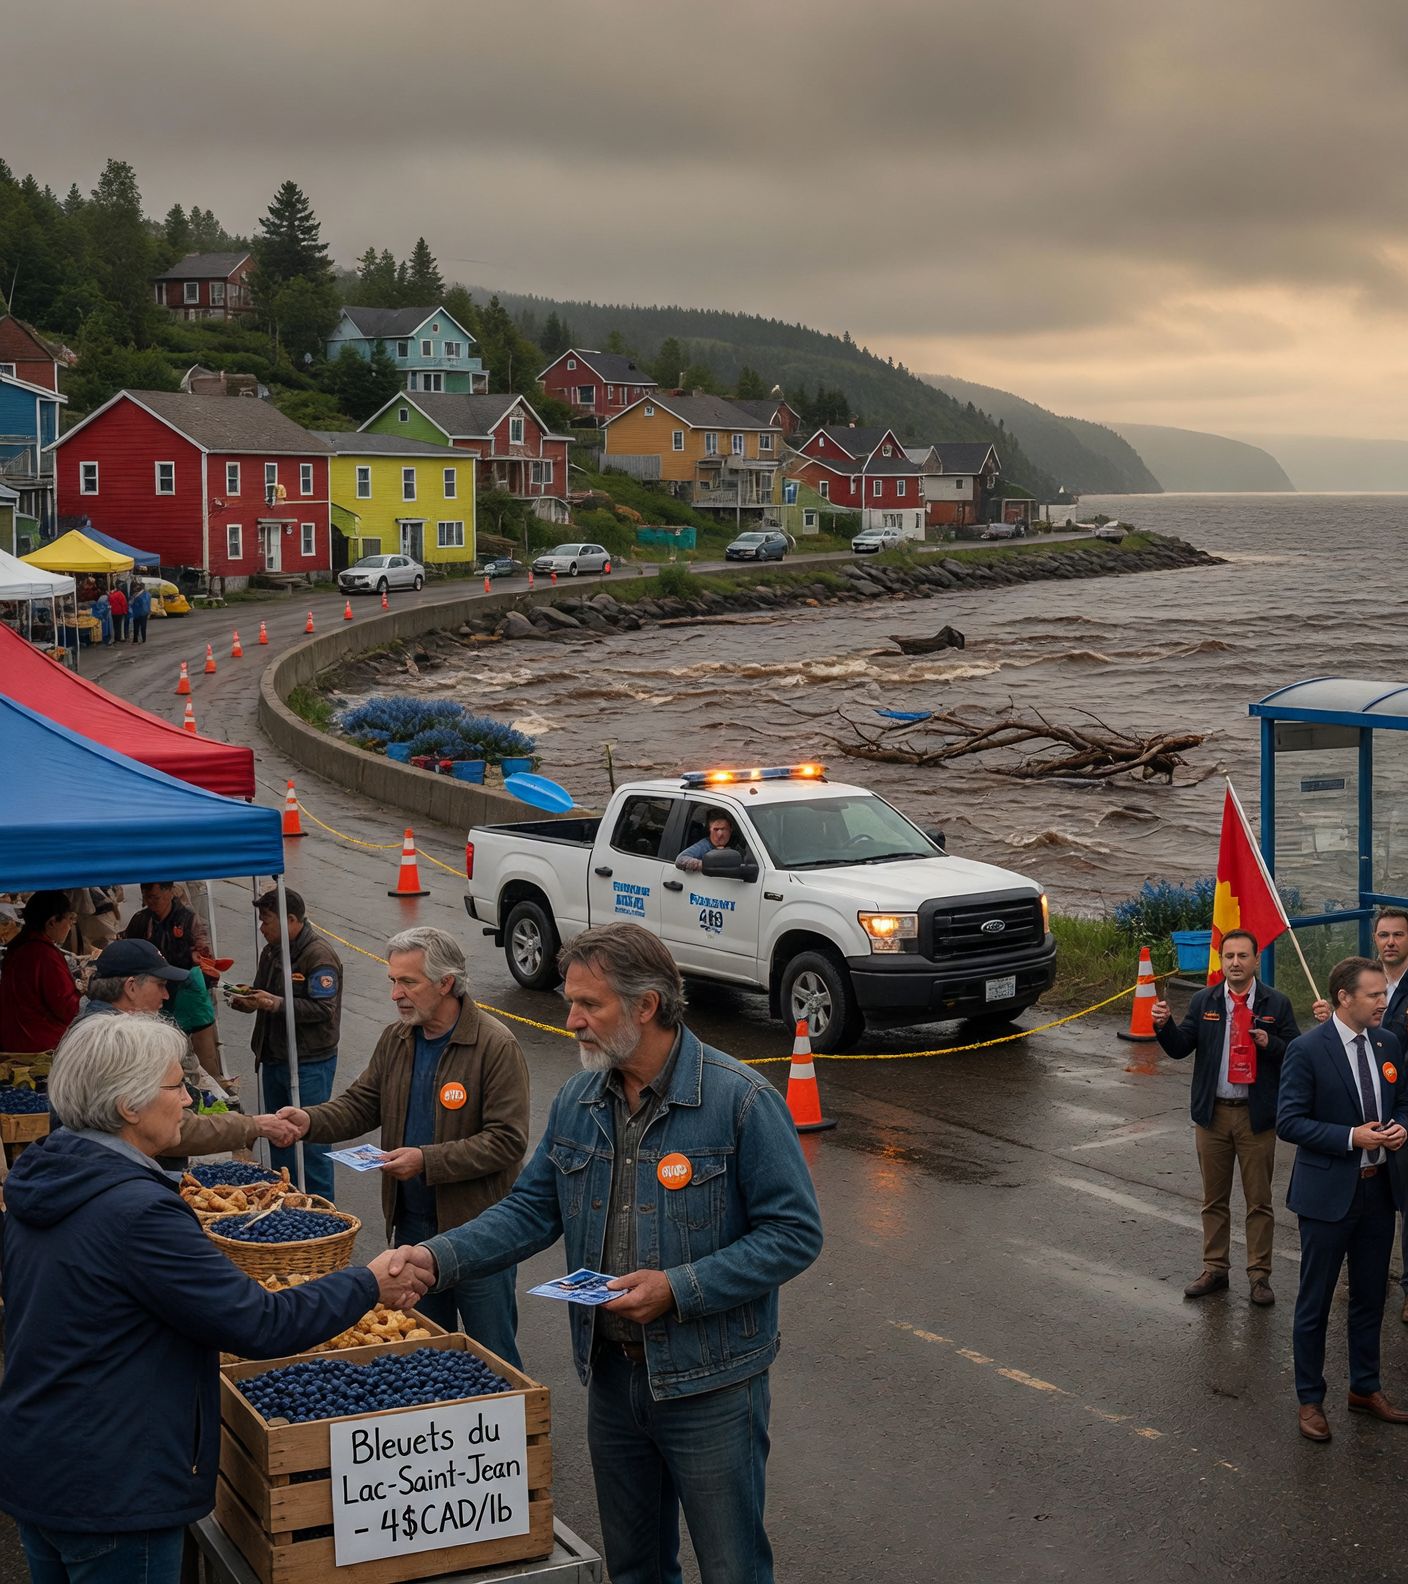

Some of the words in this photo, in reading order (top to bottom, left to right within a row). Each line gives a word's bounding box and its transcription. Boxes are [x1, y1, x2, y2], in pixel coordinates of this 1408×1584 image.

[351, 1421, 454, 1464] Bleuets
[468, 1413, 500, 1444] du
[342, 1453, 521, 1505] Lac-Saint-Jean
[381, 1492, 513, 1543] 4$CAD/lb
